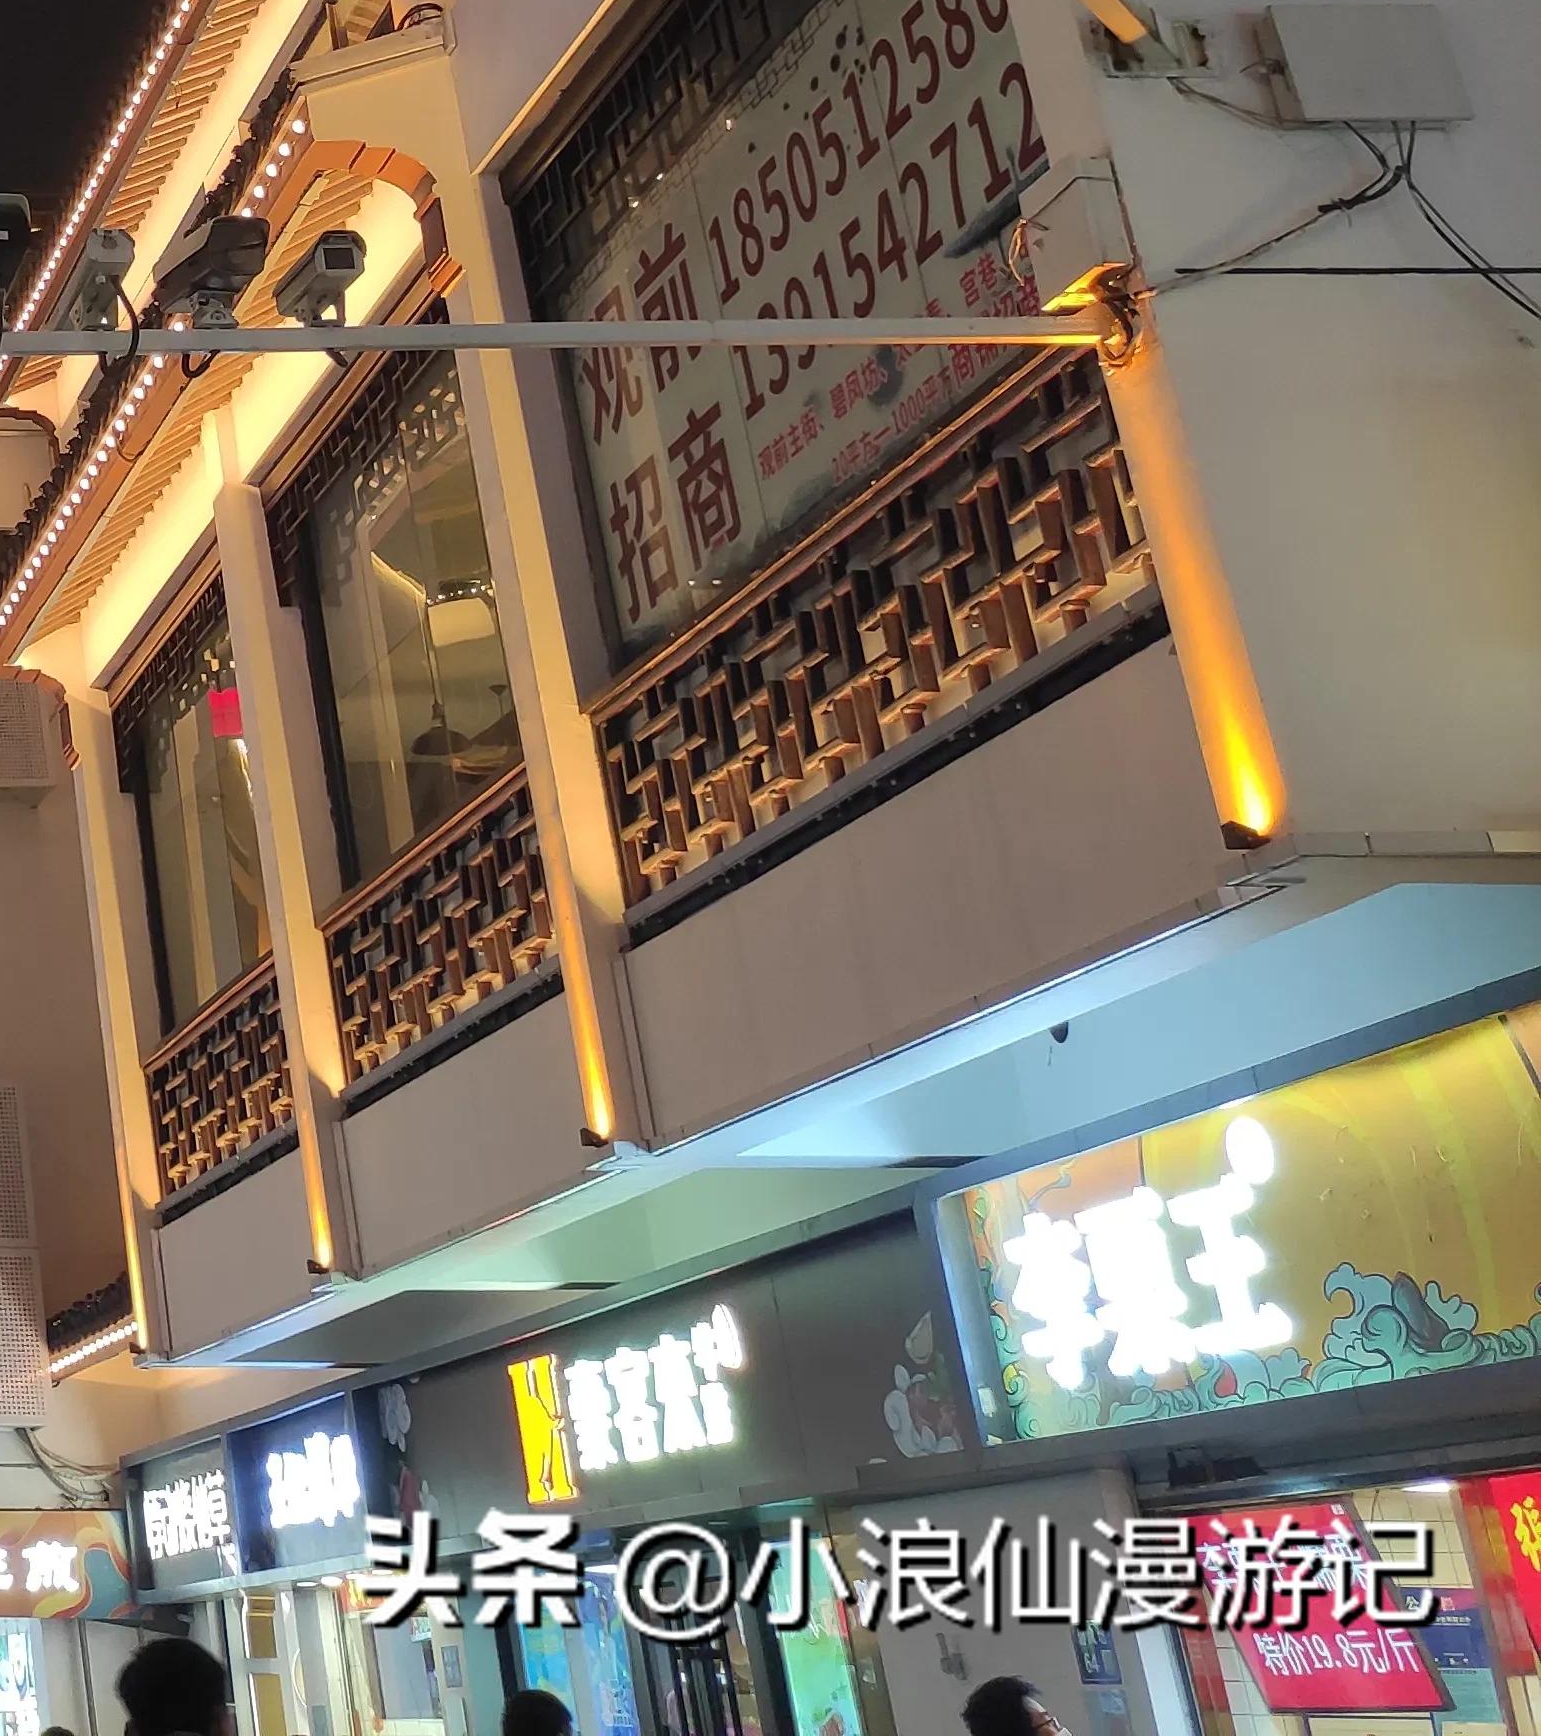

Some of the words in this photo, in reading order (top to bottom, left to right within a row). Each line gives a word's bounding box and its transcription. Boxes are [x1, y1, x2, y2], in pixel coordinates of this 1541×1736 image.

[609, 400, 743, 626] 招商
[1253, 1627, 1417, 1676] 特价19.8元/斤
